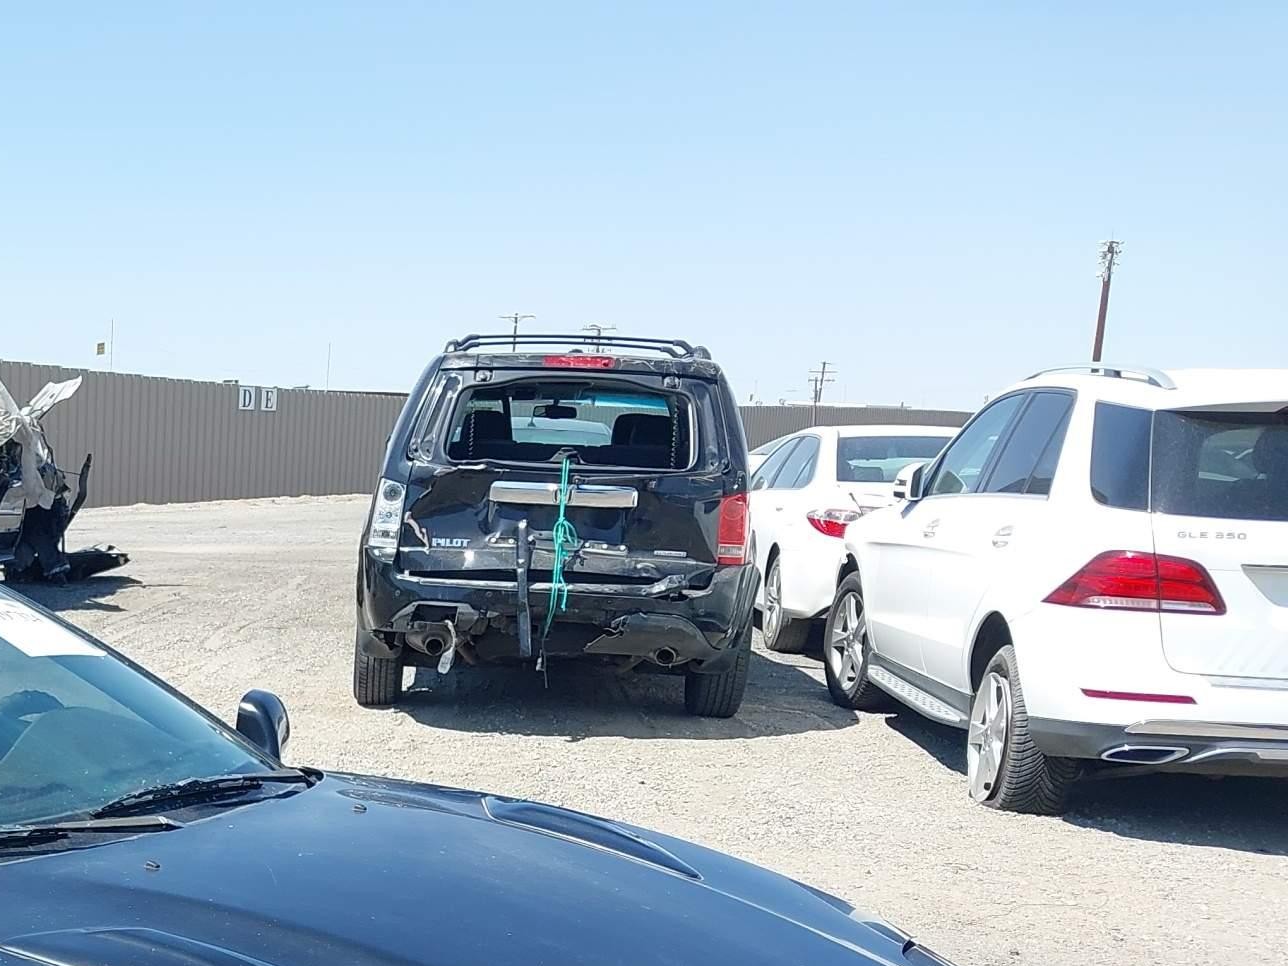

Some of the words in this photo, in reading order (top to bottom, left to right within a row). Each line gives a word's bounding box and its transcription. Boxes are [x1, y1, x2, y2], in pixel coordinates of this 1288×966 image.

[242, 389, 252, 408] D
[264, 390, 274, 409] E
[1177, 531, 1208, 539] GLE
[1215, 531, 1247, 540] 350
[432, 537, 471, 548] PILOT
